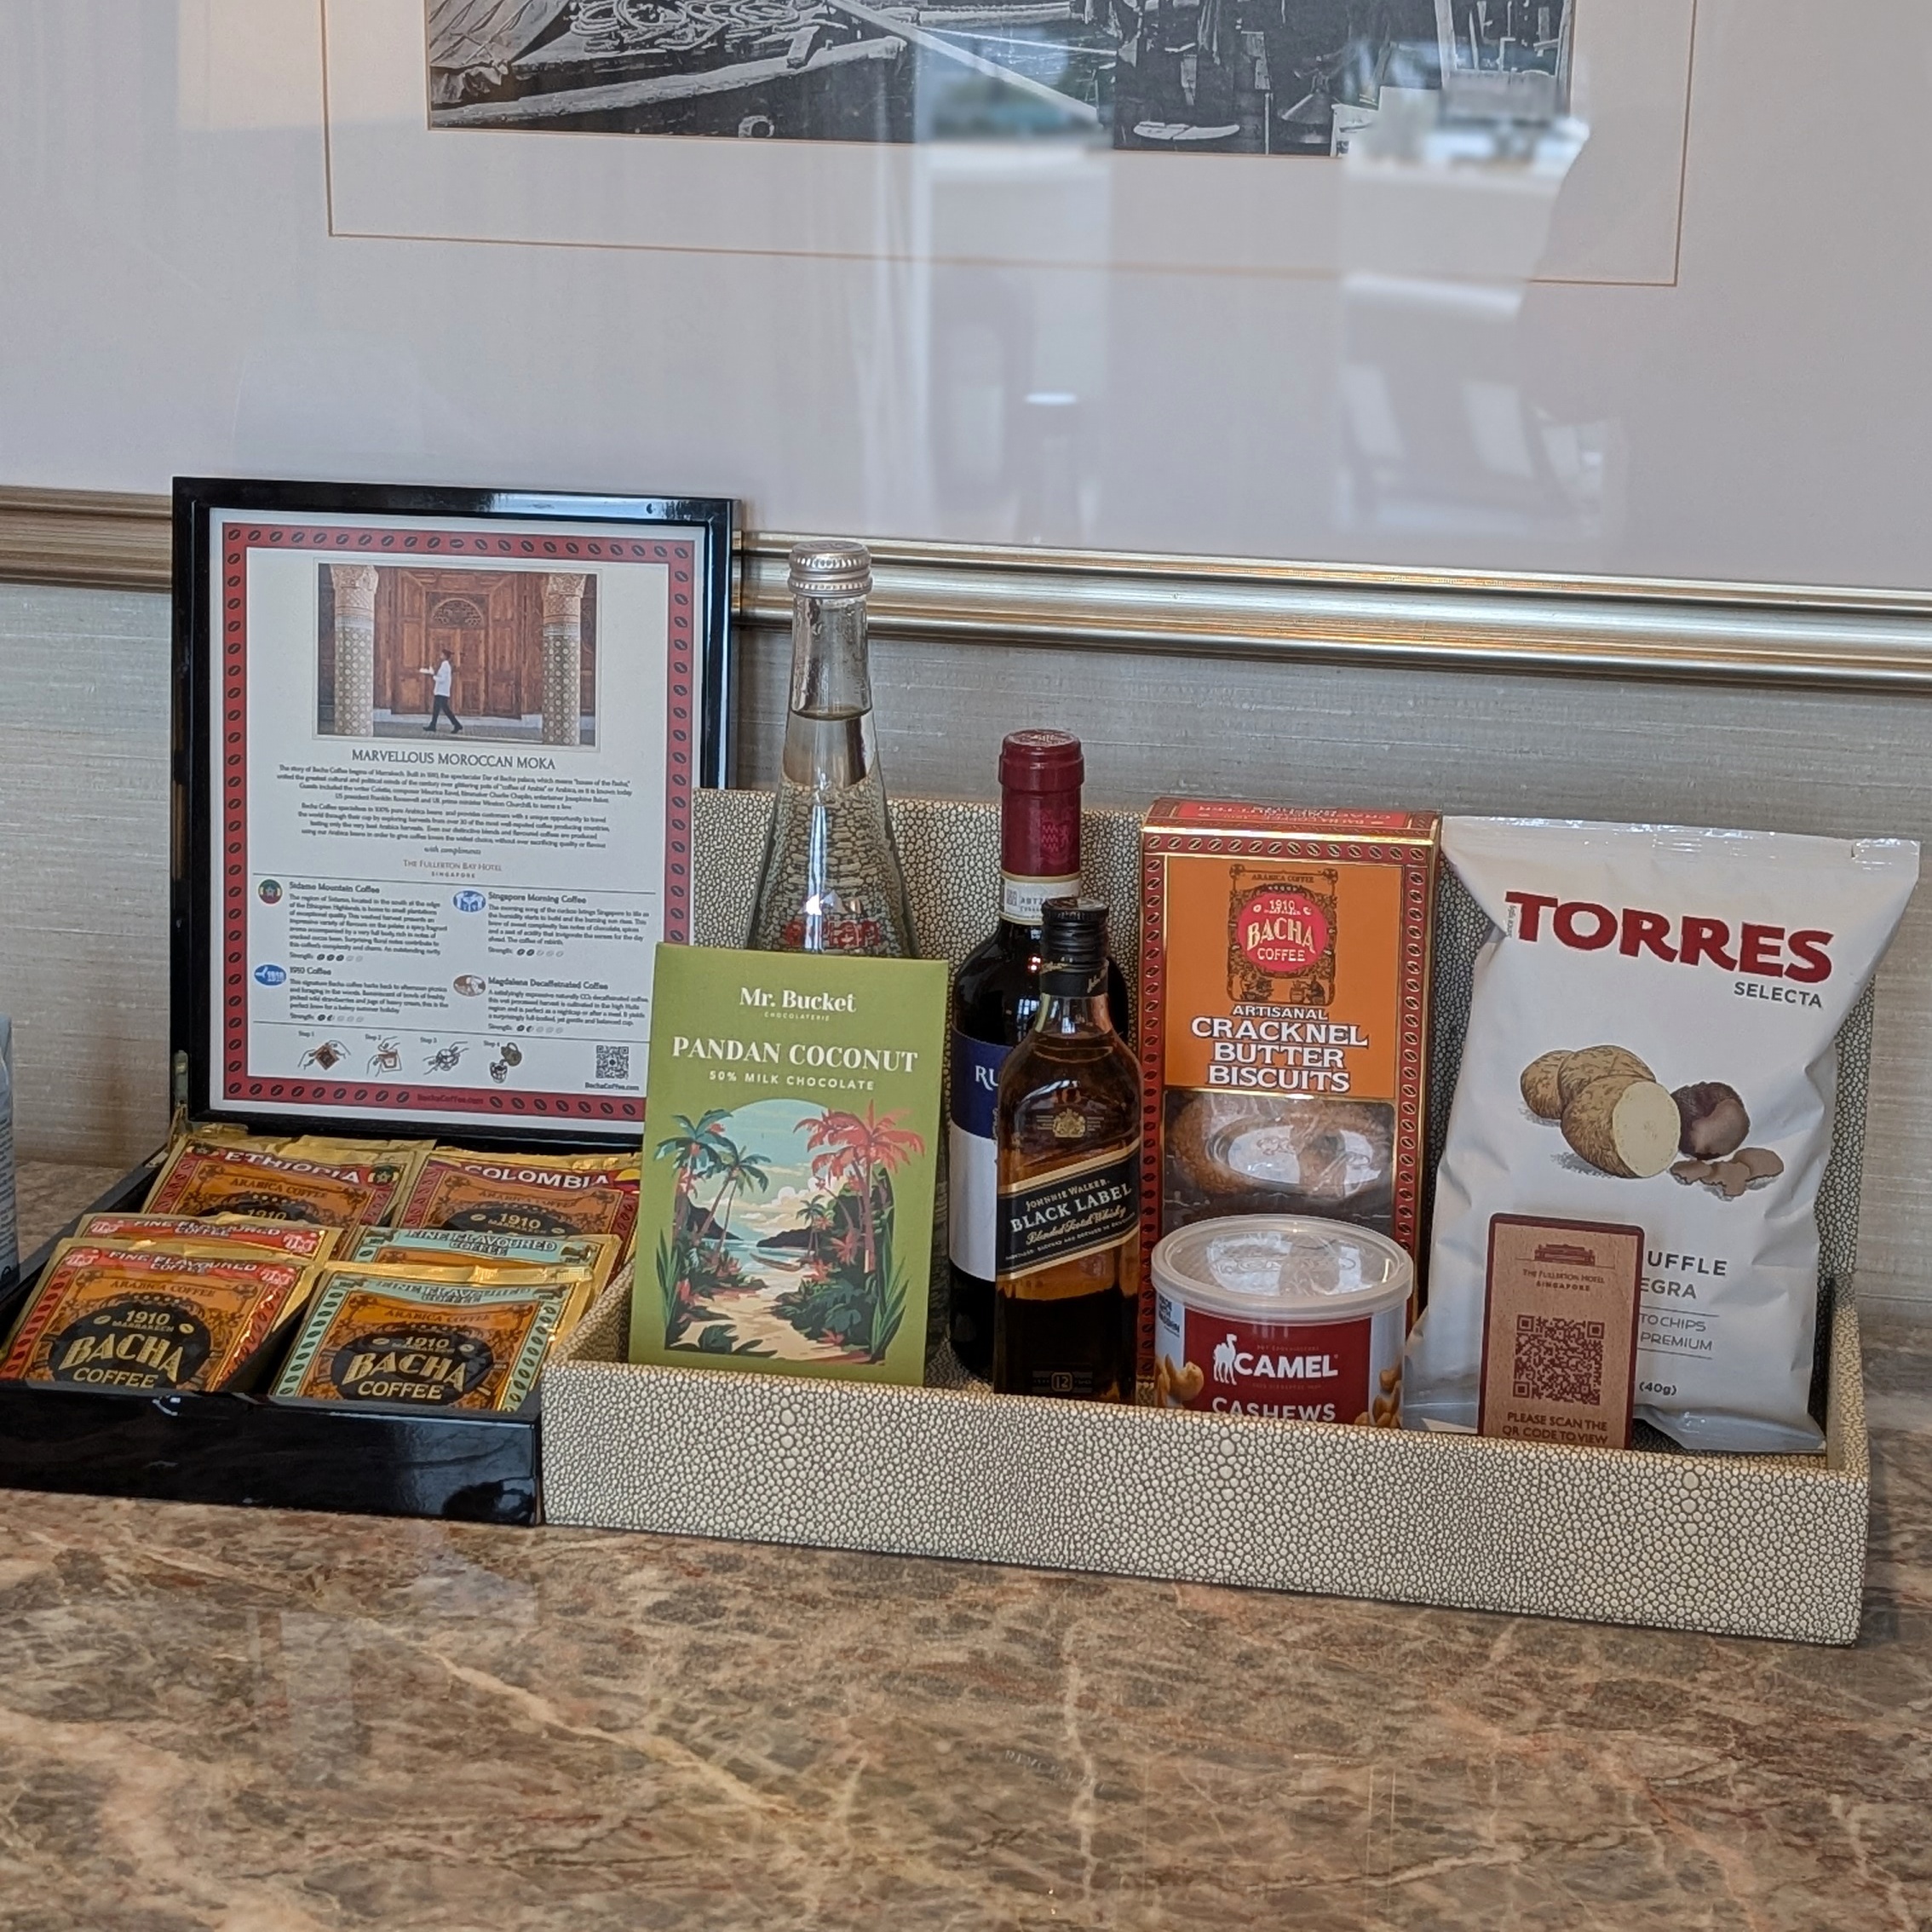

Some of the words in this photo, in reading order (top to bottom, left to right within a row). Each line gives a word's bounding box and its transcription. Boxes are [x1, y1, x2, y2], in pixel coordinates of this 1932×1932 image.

[352, 750, 434, 764] MARVELLOUS
[438, 752, 513, 768] MOROCCAN
[517, 756, 555, 770] MOKA
[479, 863, 503, 871] HOTEL
[319, 883, 353, 893] Mountain
[355, 884, 380, 894] Coffee
[488, 892, 526, 902] Singapore
[528, 894, 560, 905] Morning
[561, 895, 586, 905] Coffee
[1269, 900, 1295, 910] 1910
[784, 916, 881, 948] eian
[1246, 917, 1316, 954] BACHA
[1505, 890, 1835, 984] TORRES
[1257, 947, 1305, 962] COFFEE
[307, 967, 331, 976] Coffee
[584, 981, 608, 990] Coffee
[1733, 980, 1823, 1009] SELECTA
[739, 986, 776, 1008] Mr.
[781, 989, 857, 1013] Bucket
[764, 1011, 831, 1022] CHOCOLATERIE
[1232, 1004, 1328, 1021] ARTISANAL
[1190, 1015, 1370, 1049] CRACKNEL
[672, 1036, 782, 1064] PANDAN
[789, 1044, 918, 1073] COCONUT
[1212, 1041, 1345, 1070] BUTTER
[709, 1070, 738, 1082] 50%
[745, 1072, 780, 1085] MILK
[786, 1075, 875, 1091] CHOCOLATE
[1207, 1065, 1351, 1094] BISCUITS
[224, 1151, 361, 1185] ETHIOPIA
[464, 1164, 609, 1189] COLOMBIA
[1025, 1190, 1068, 1212] JOHNNIE
[1068, 1178, 1107, 1196] WALKER
[1010, 1202, 1072, 1233] BLACK
[1074, 1182, 1132, 1212] LABEL
[500, 1213, 542, 1229] 1910
[452, 1229, 557, 1251] FLAVOURED
[107, 1251, 152, 1262] FINE
[153, 1256, 258, 1271] FLAVOURED
[171, 1283, 216, 1297] COFFEE
[1536, 1279, 1590, 1291] SINGAPORE
[127, 1309, 170, 1325] 1910
[405, 1335, 450, 1348] 1910
[1640, 1331, 1713, 1351] PREMIUM
[58, 1332, 184, 1383] BACHA
[1234, 1352, 1339, 1379] CAMEL
[72, 1366, 159, 1389] COFFEE
[342, 1350, 466, 1393] BACHA
[358, 1380, 446, 1400] COFFEE
[1639, 1381, 1677, 1396] (40g)
[1211, 1396, 1337, 1423] CASHEWS
[1507, 1411, 1547, 1425] PLEASE
[1550, 1416, 1584, 1429] SCAN
[1584, 1419, 1608, 1432] THE
[1502, 1425, 1520, 1437] QR
[1522, 1427, 1557, 1440] CODE
[1559, 1431, 1576, 1441] TO
[1577, 1434, 1608, 1445] VIEW
